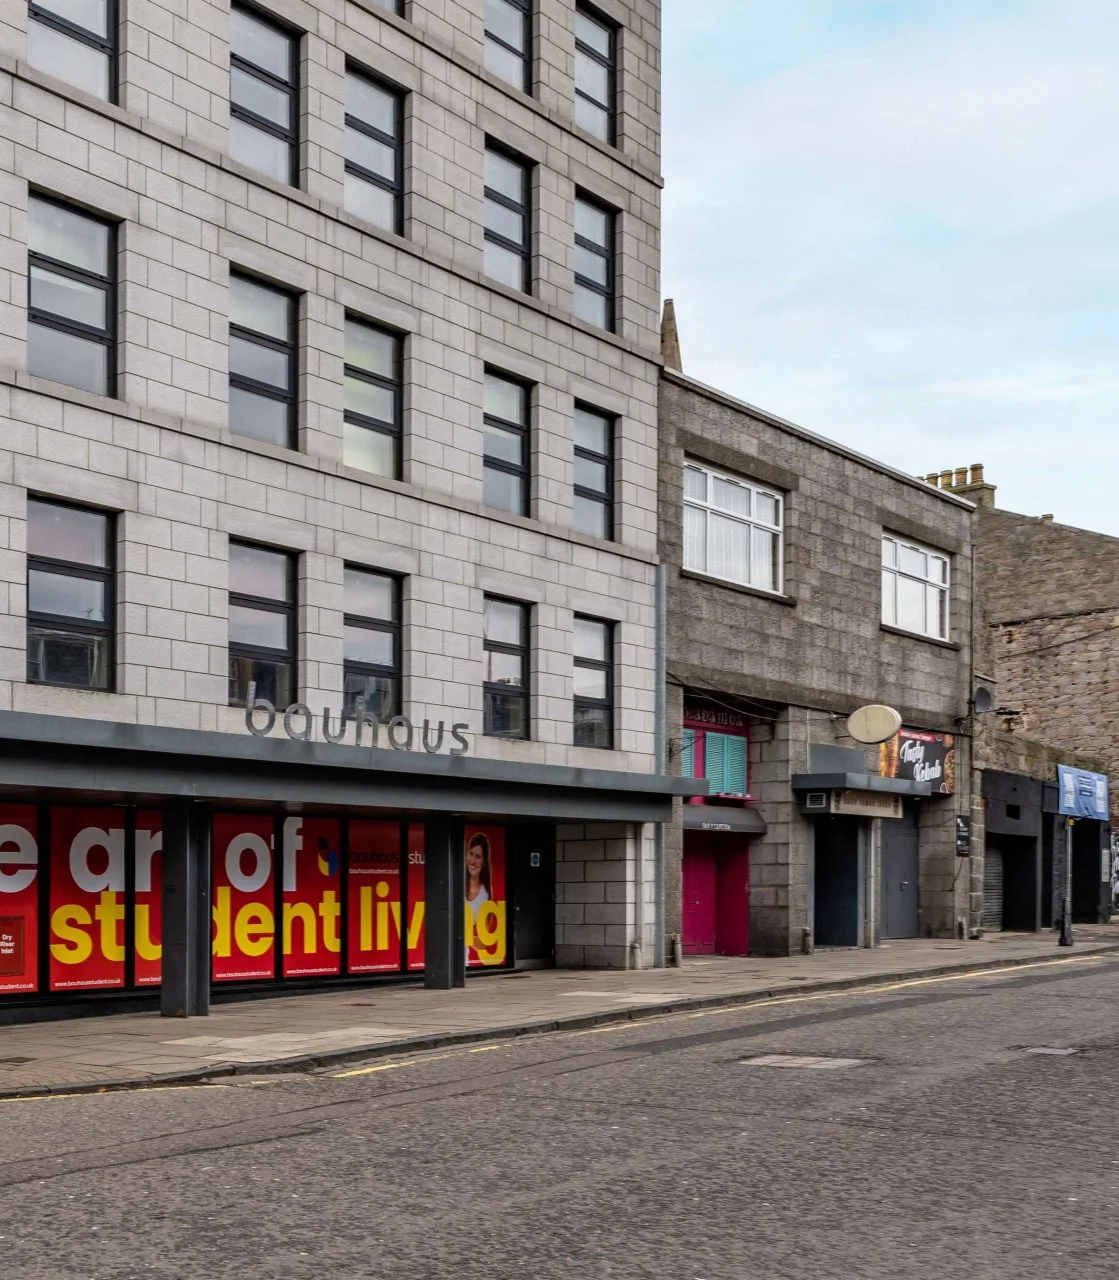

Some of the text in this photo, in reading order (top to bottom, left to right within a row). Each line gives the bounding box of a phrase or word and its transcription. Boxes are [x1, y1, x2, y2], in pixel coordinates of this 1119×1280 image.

[245, 680, 469, 756] bauhaus
[900, 739, 925, 763] Tasty
[913, 759, 942, 782] Kebab
[68, 825, 163, 893] ar
[224, 816, 304, 893] of
